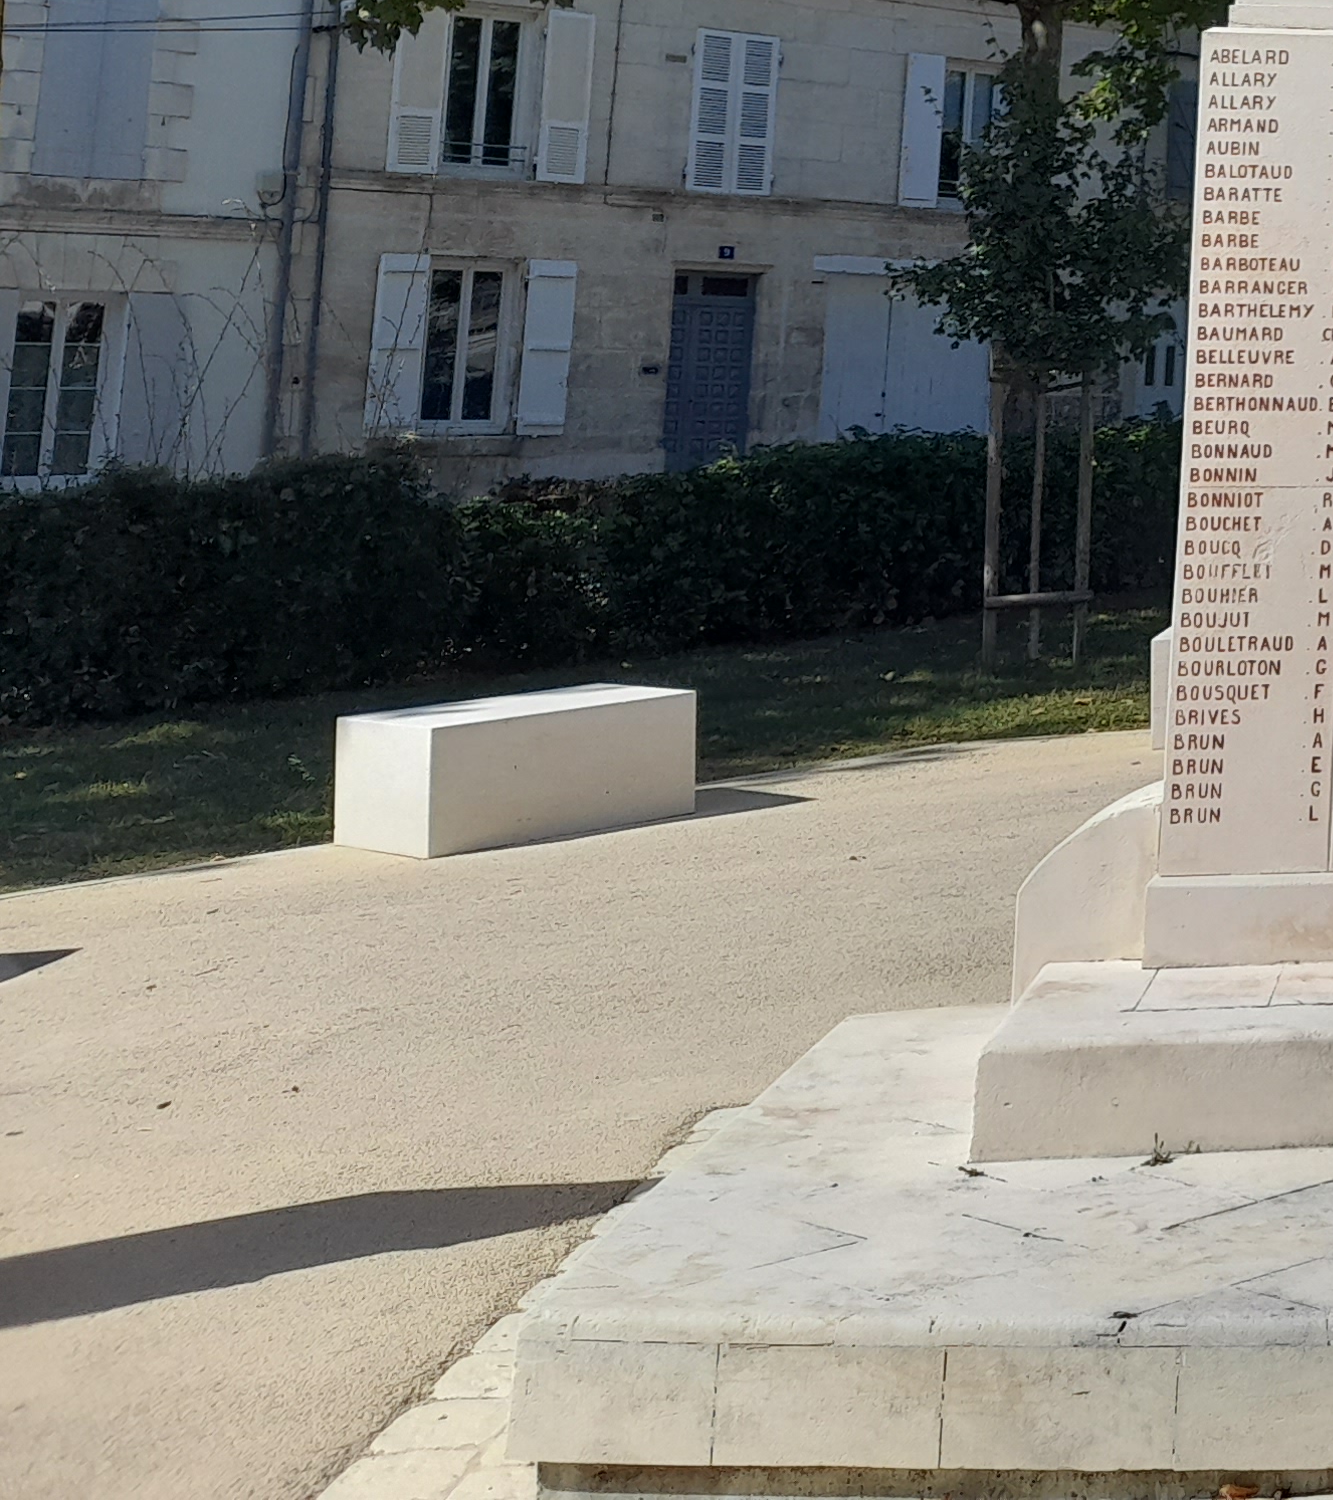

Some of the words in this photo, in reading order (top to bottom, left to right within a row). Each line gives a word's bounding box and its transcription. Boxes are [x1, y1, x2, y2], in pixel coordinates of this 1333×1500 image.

[1210, 49, 1289, 65] ABELARD
[1210, 72, 1277, 87] ALLARY
[1208, 95, 1276, 110] ALLARY
[1207, 118, 1278, 133] ARMAND
[1207, 141, 1259, 155] AUBIN
[1205, 164, 1292, 179] BALOTAUD
[1204, 187, 1282, 202] BARATTE
[1203, 210, 1260, 225] BARBE
[1202, 234, 1258, 248] BARBE
[723, 247, 731, 257] 9
[1201, 257, 1300, 272] BARBOTEAU
[1200, 280, 1307, 295] BARRANGER
[1198, 326, 1283, 341] BAUMARD
[1197, 350, 1294, 364] BELLEUVRE
[1195, 373, 1273, 388] BERNARD
[1194, 397, 1318, 411] BERTHONNAUD
[1192, 444, 1272, 458] BONNAUD
[1190, 468, 1257, 482] BONNIN
[1188, 492, 1263, 507] BONNIOT
[1186, 516, 1261, 531] BOUCHET
[1181, 612, 1249, 628] BOUJUT
[1180, 636, 1293, 652] BOULETRAUD
[1178, 660, 1281, 676] BOURLOTON
[1177, 684, 1270, 704] BOUSQUET
[1176, 709, 1240, 725] BRIVES
[1174, 734, 1224, 750] BRUN
[1172, 759, 1223, 775] BRUN
[1171, 783, 1222, 800] BRUN
[1170, 808, 1220, 824] BRUN
